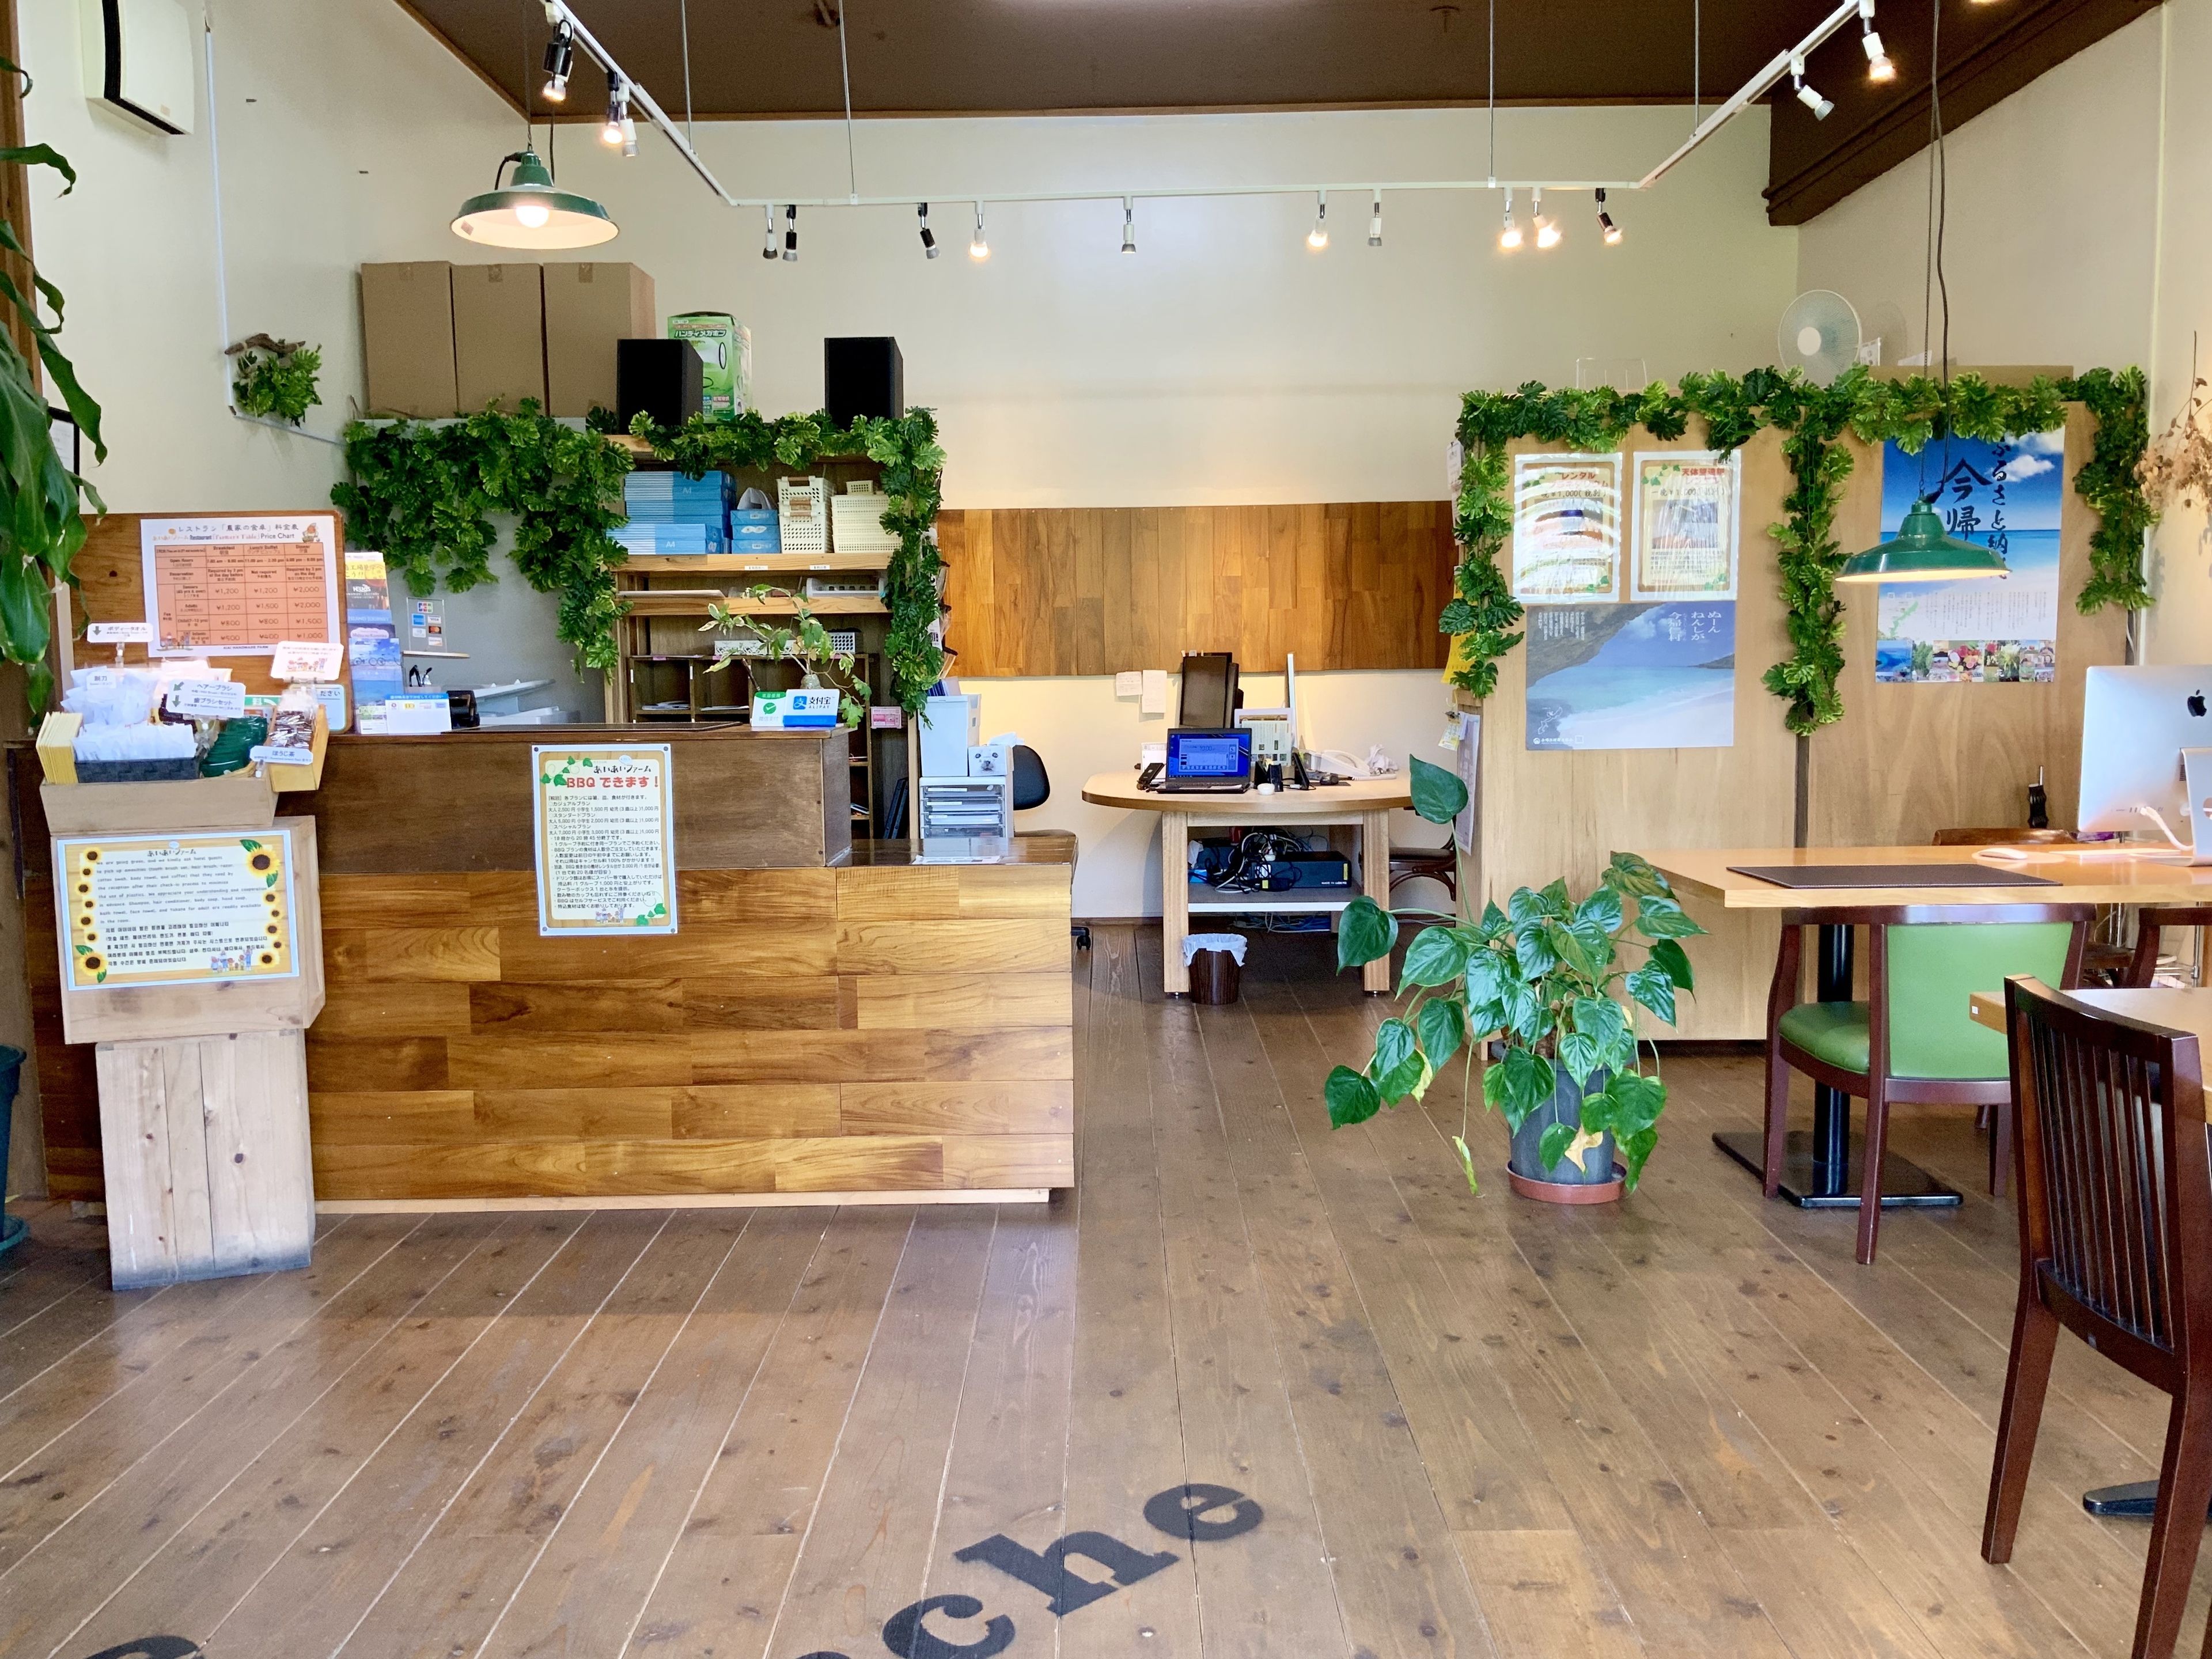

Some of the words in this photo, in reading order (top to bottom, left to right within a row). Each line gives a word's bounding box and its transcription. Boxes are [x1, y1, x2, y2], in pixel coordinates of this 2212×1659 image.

[674, 329, 726, 338] ハンディメガホン
[1561, 472, 1596, 480] レンタル
[1988, 441, 2011, 579] ふるさと納
[1691, 611, 1705, 641] ねんしが
[1707, 611, 1721, 633] ぬーん
[197, 683, 233, 692] ヘアーブラシ
[194, 697, 233, 706] 歯ブラシセット
[809, 696, 831, 705] 支付宝
[593, 764, 652, 774] あいあいファーム
[567, 777, 596, 789] BBQ
[794, 1483, 1263, 1659] che
